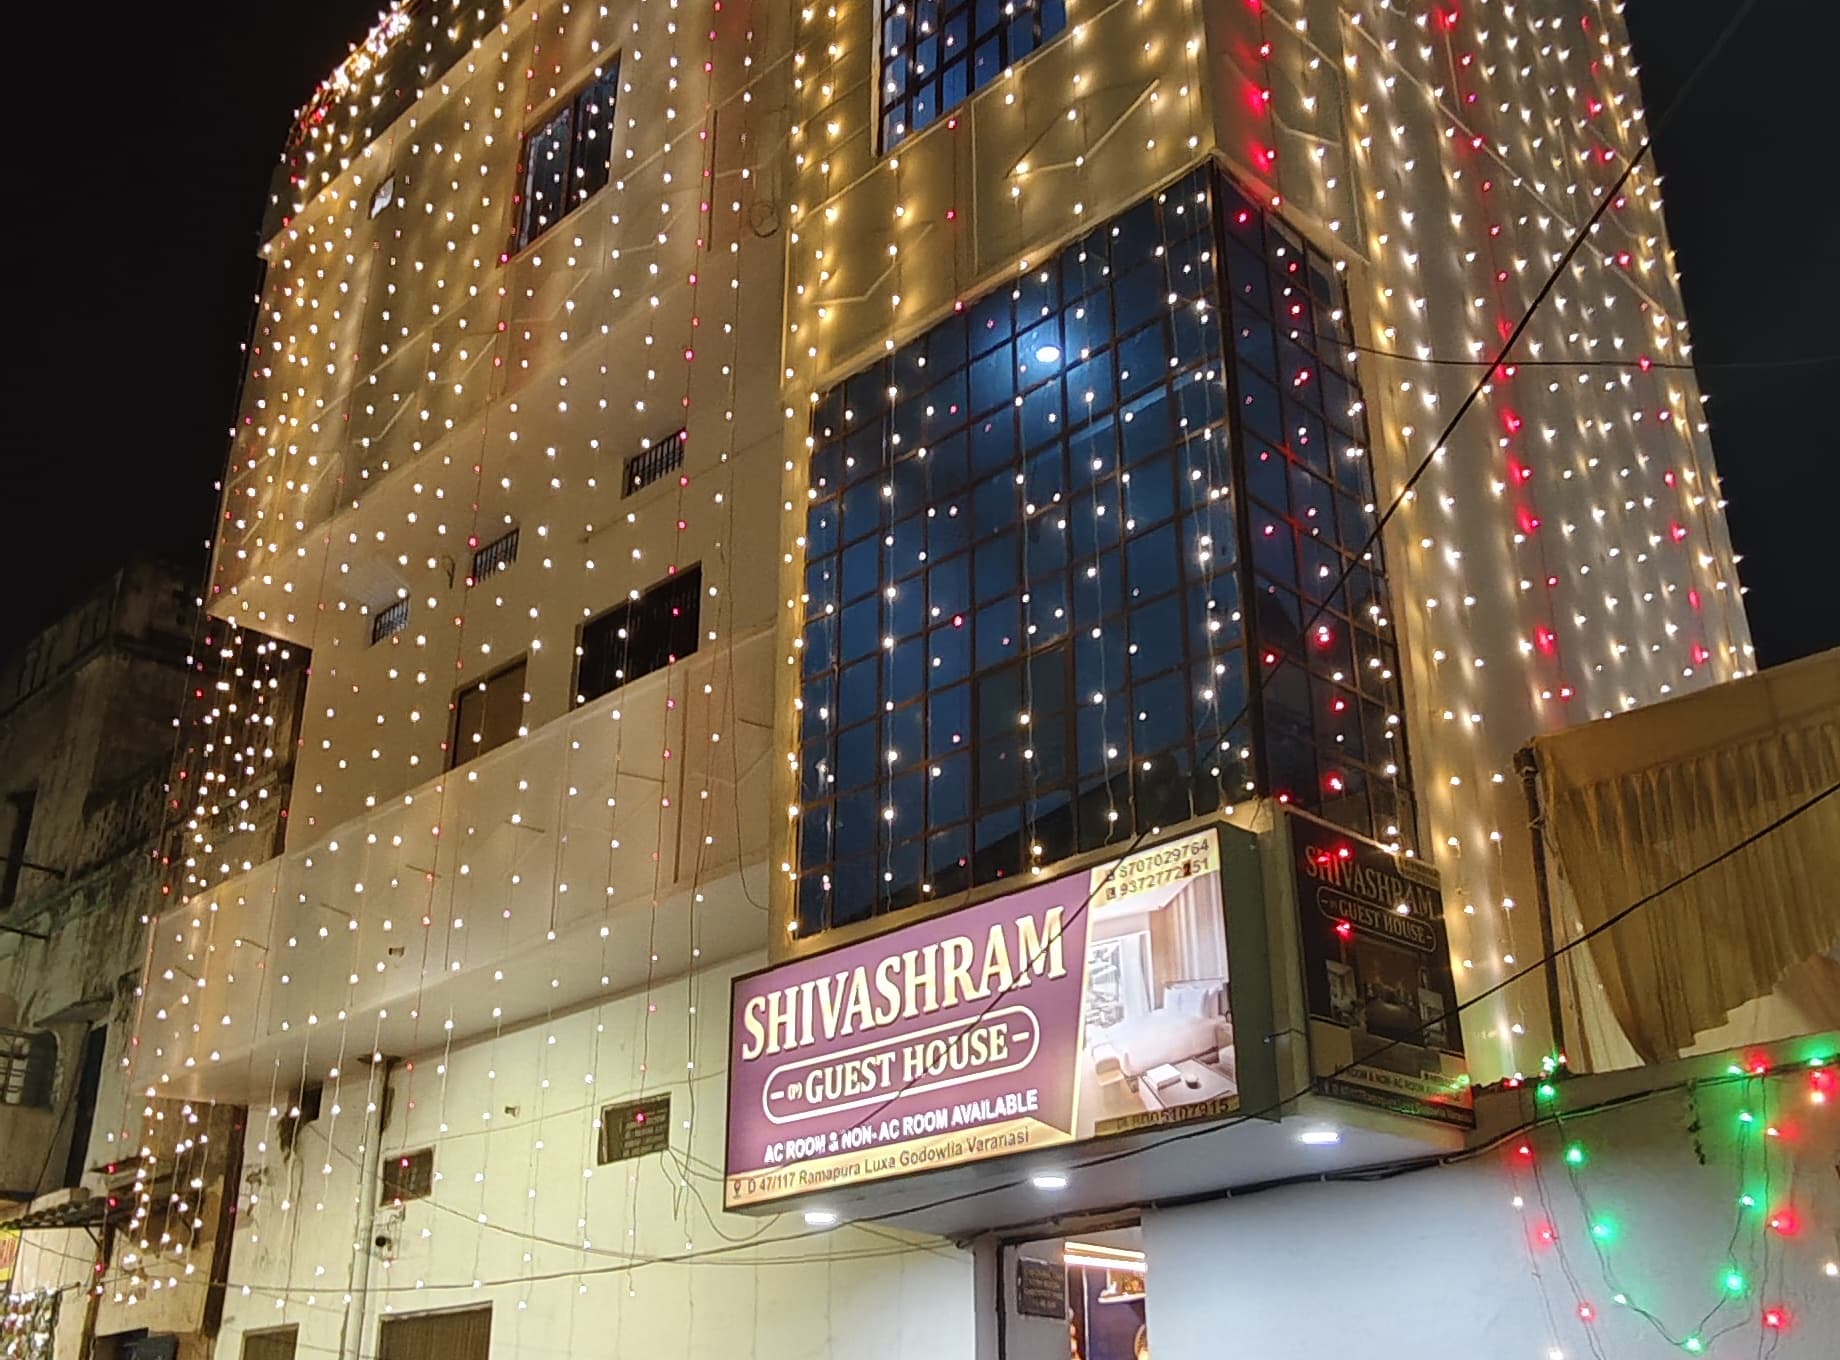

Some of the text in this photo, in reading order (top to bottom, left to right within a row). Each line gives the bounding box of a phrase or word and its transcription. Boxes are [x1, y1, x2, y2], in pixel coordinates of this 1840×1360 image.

[1338, 897, 1426, 944] GUEST HOUSE
[742, 906, 1067, 1060] SHIVASHRAM
[804, 1051, 896, 1104] GUEST
[902, 1022, 1009, 1082] HOUSE
[747, 1180, 756, 1195] D
[759, 1172, 796, 1191] 47/117
[799, 1163, 861, 1185] Ramapura
[864, 1155, 896, 1174] Luxa
[966, 1125, 1029, 1153] Varanasi
[763, 1142, 784, 1163] AC
[785, 1133, 827, 1160] ROOM
[902, 1107, 948, 1136] ROOM
[950, 1088, 1039, 1127] AVAILABLE
